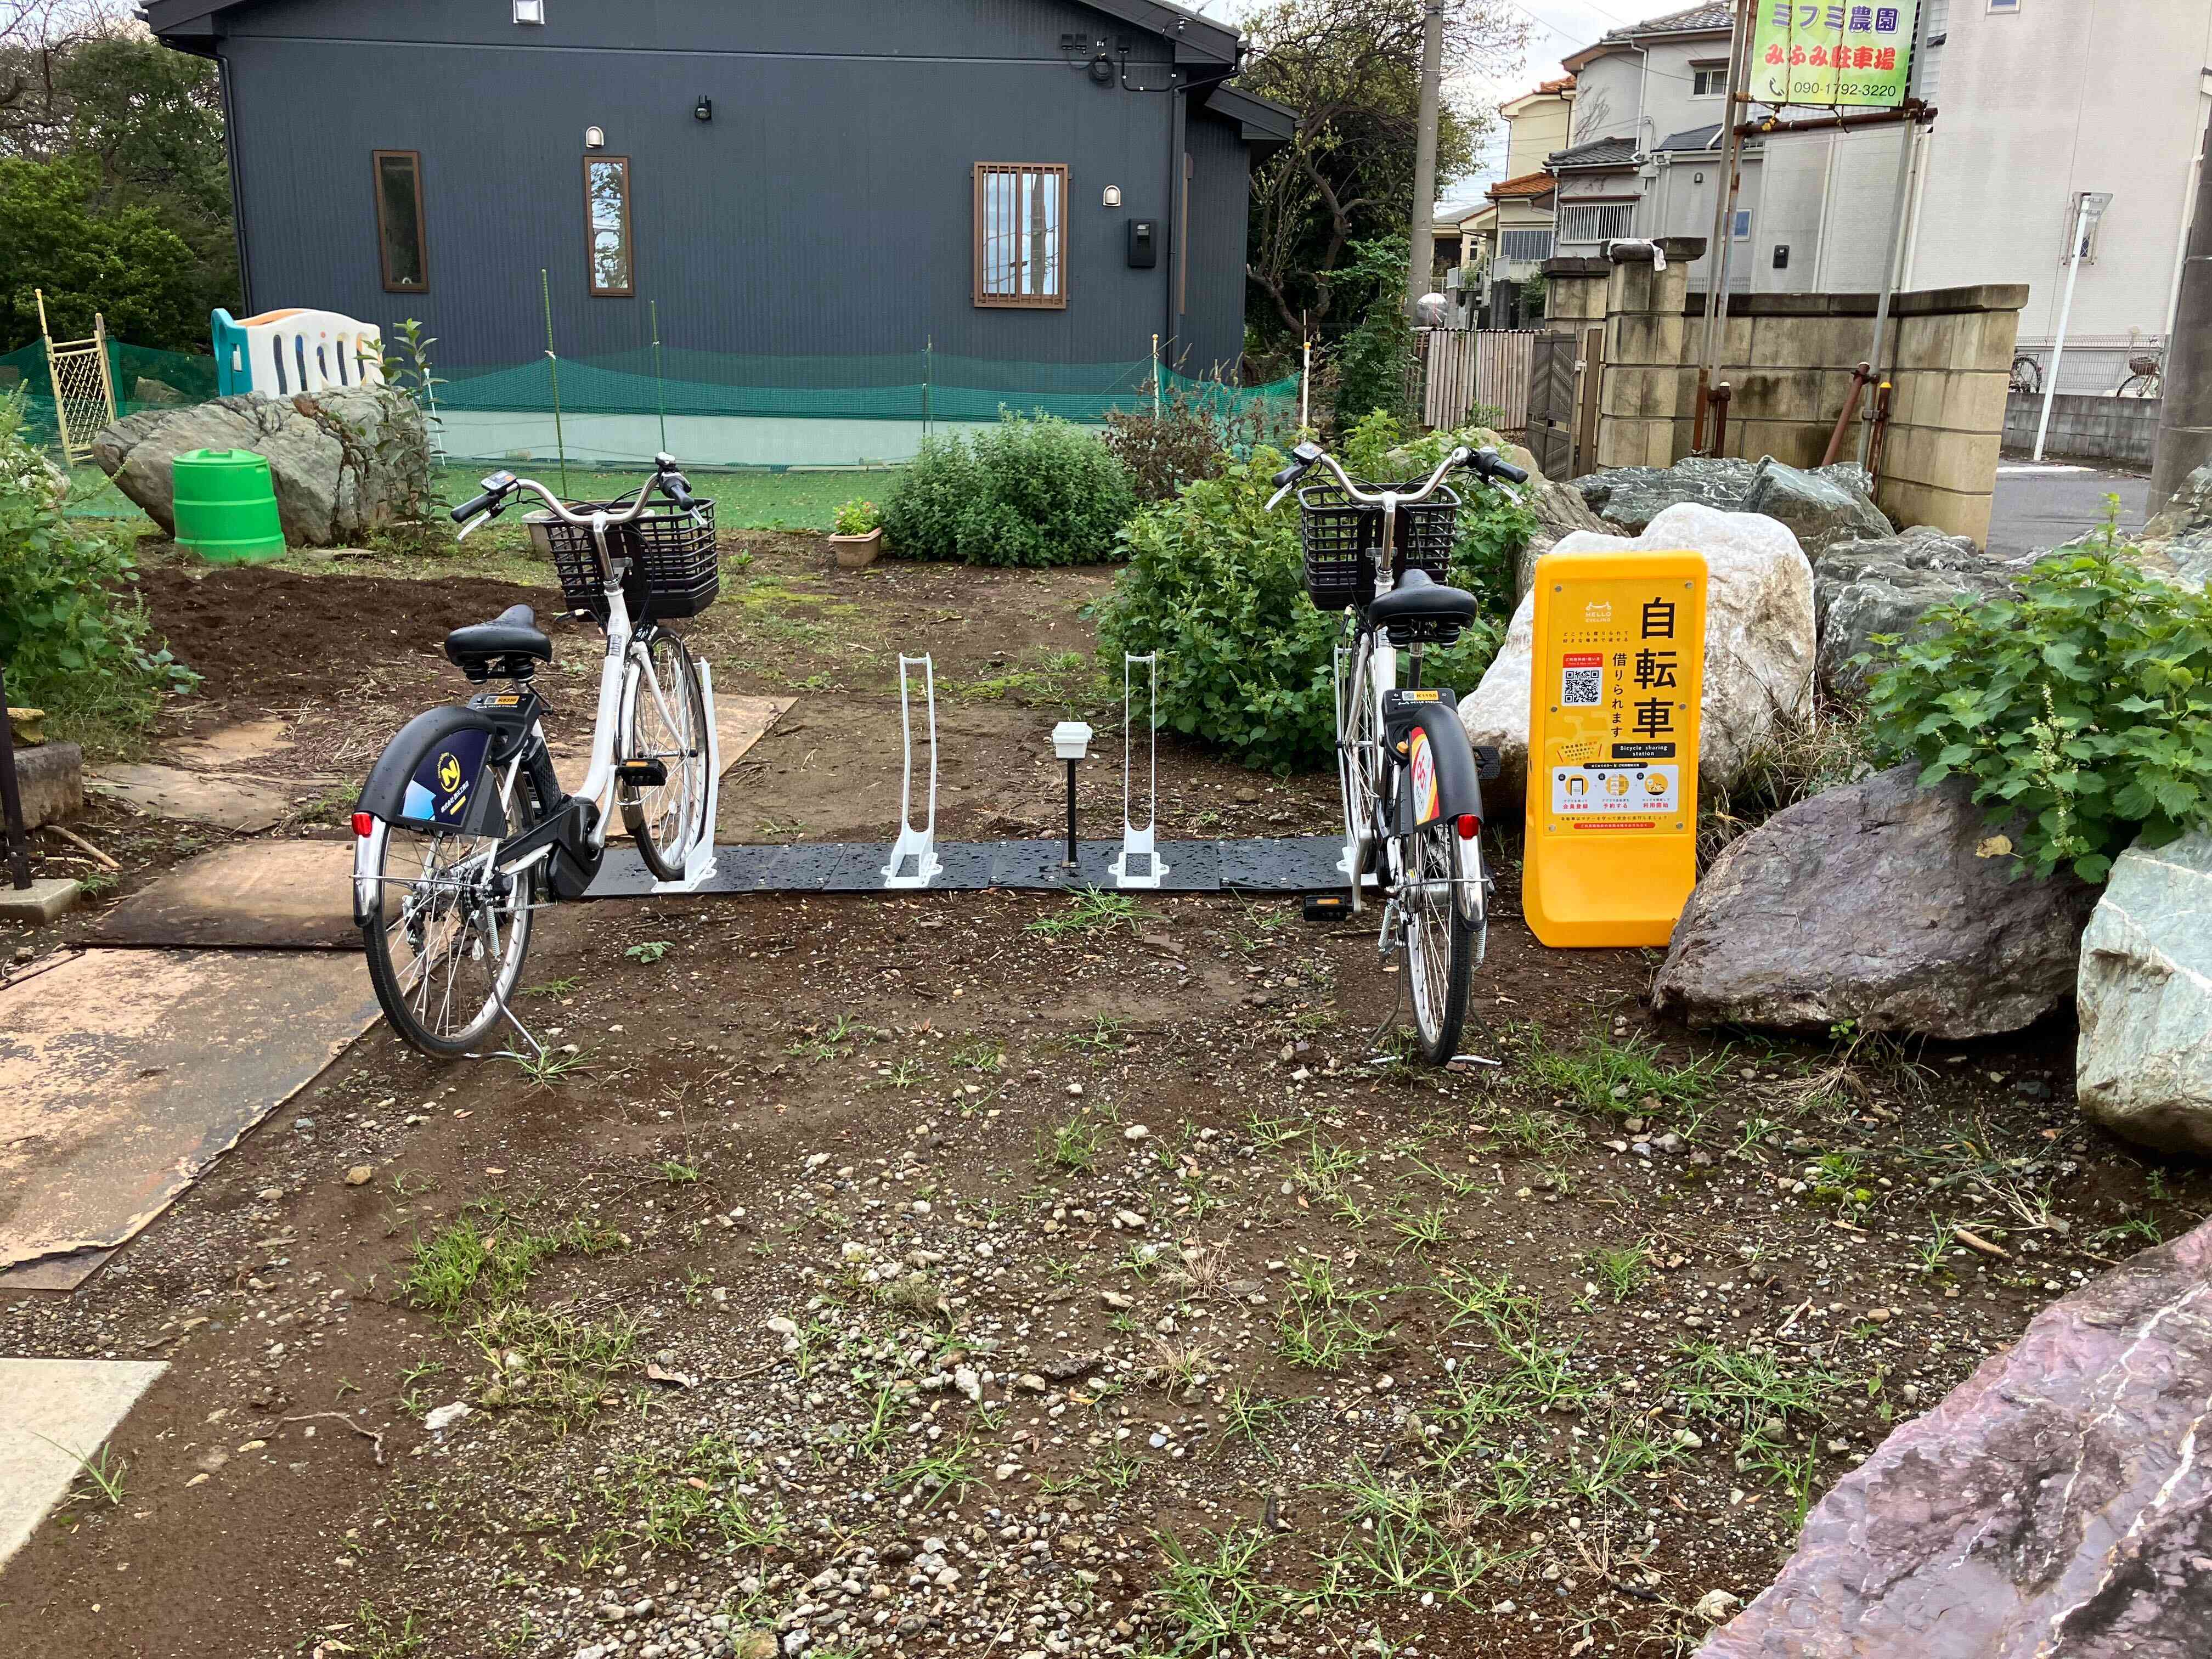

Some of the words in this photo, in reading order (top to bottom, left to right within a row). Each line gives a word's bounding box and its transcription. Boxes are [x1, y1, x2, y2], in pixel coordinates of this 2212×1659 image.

[1772, 3, 1899, 33] ミフミ農園
[1764, 43, 1896, 71] みふみ駐車場
[1794, 82, 1896, 97] 090-1792-3220
[1633, 597, 1678, 738] 自転車
[1611, 653, 1627, 738] 借りられます
